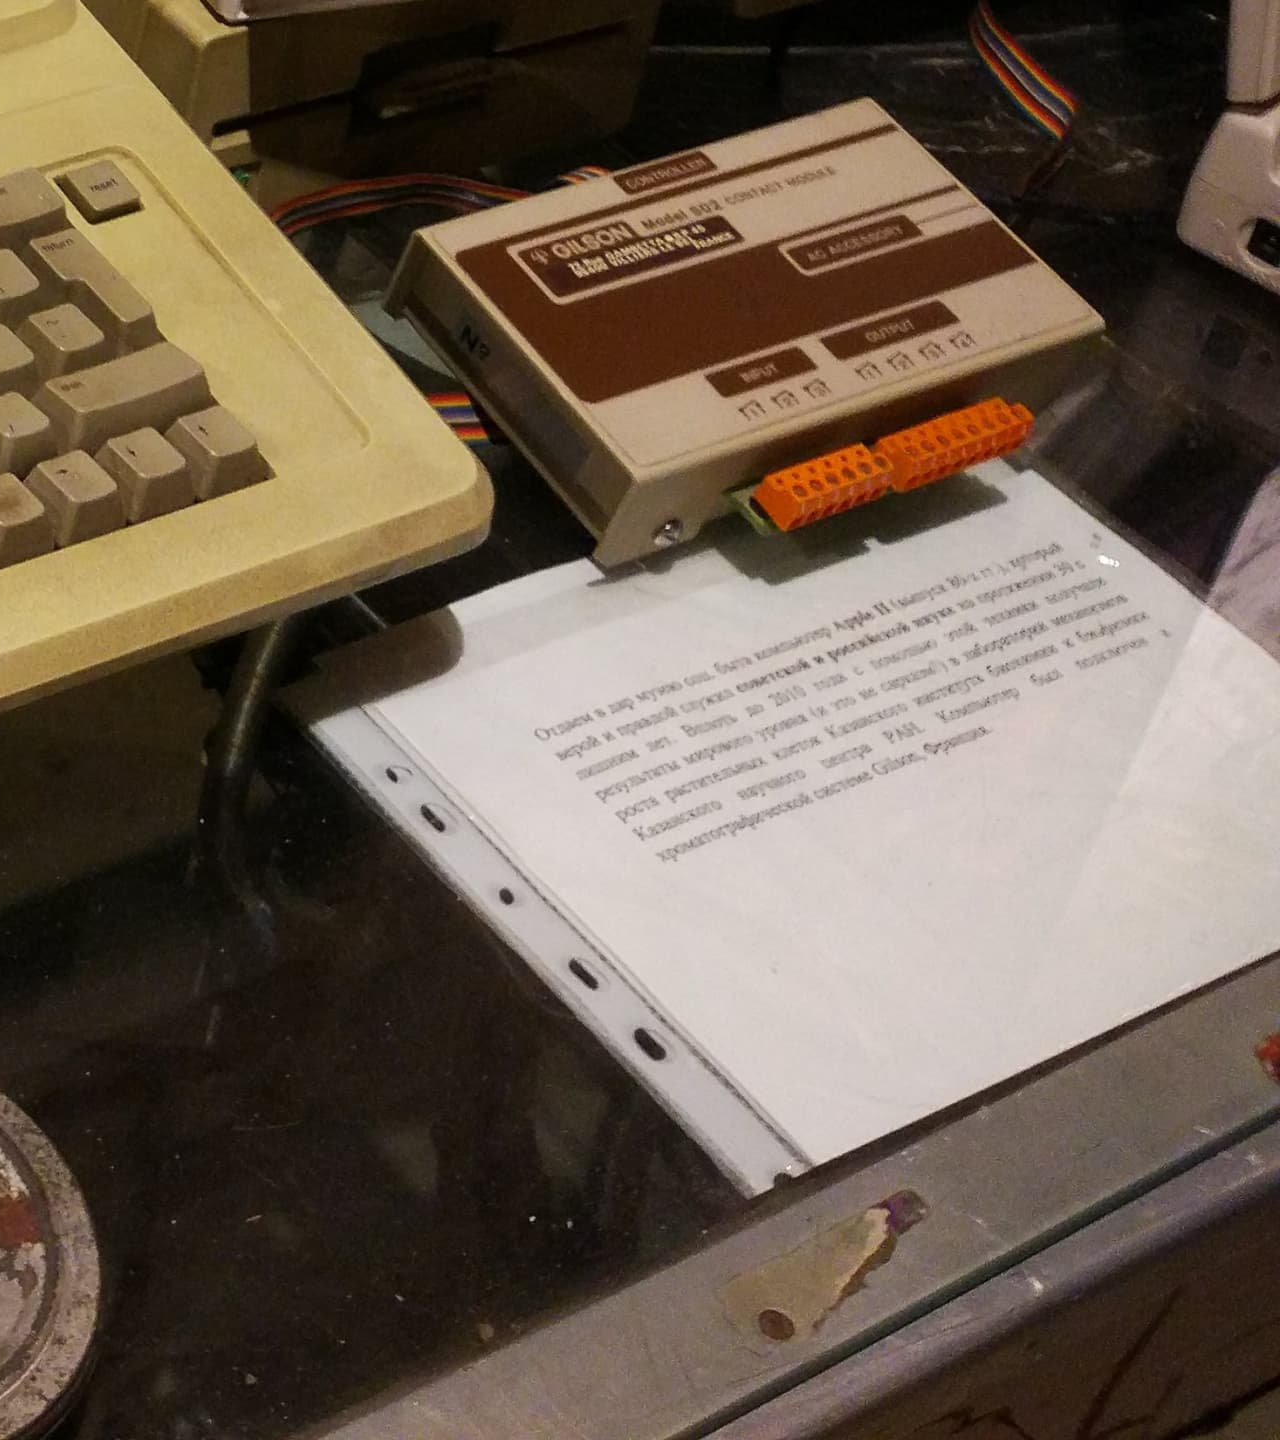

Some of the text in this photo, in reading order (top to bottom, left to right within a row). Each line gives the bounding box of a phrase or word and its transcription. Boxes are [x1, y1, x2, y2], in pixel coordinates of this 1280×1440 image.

[551, 223, 635, 261] GILSON
[640, 208, 686, 233] Model
[833, 610, 874, 630] Apple
